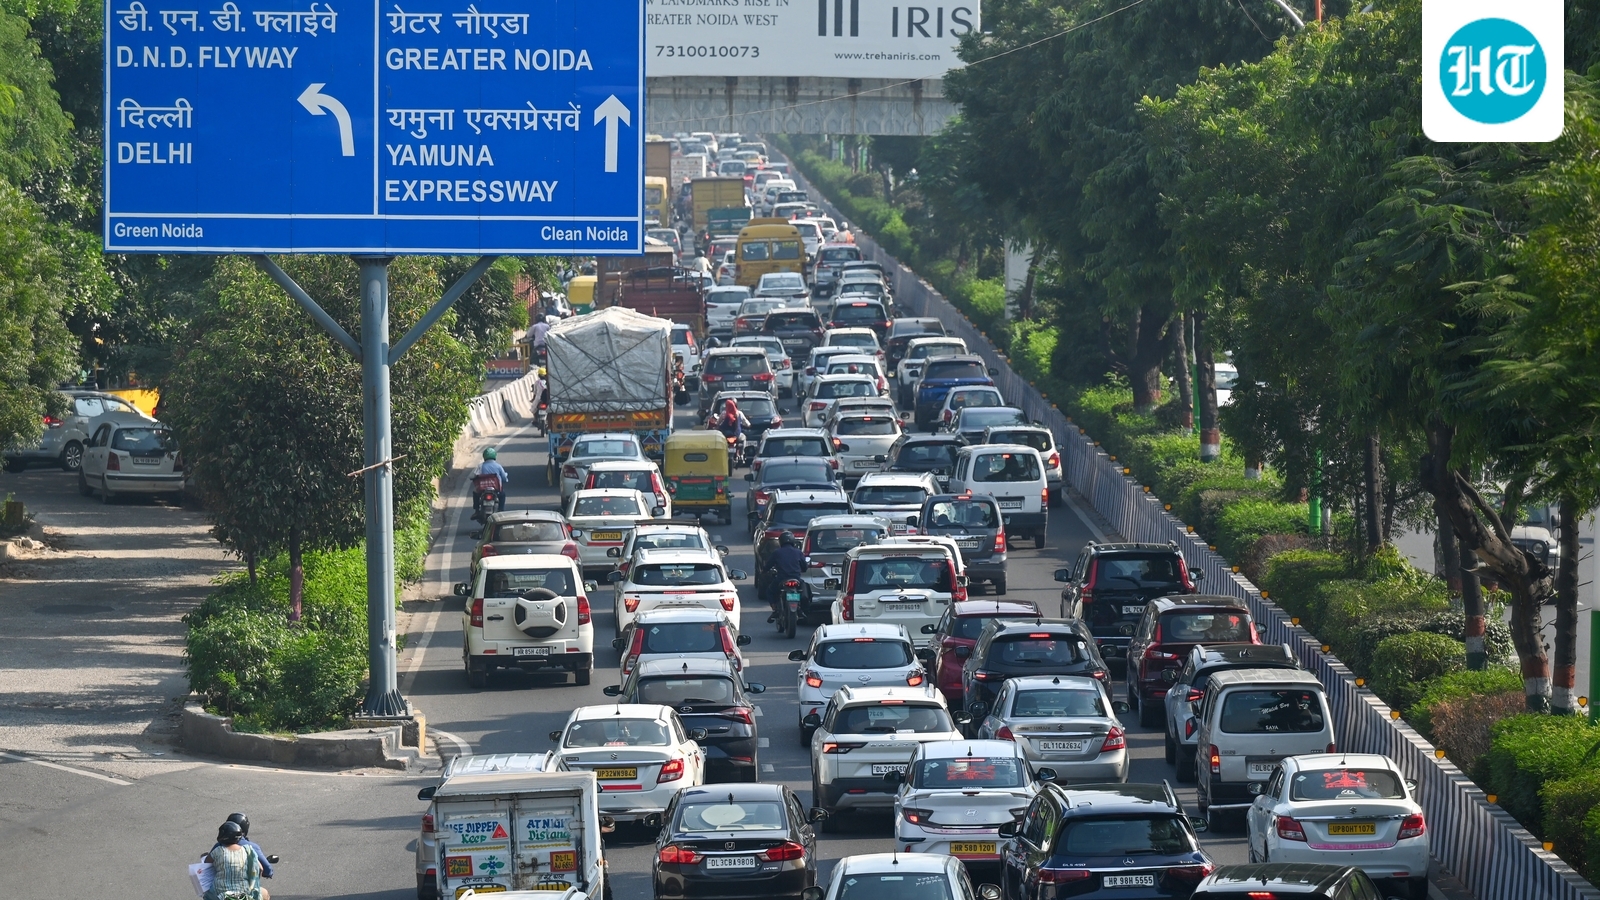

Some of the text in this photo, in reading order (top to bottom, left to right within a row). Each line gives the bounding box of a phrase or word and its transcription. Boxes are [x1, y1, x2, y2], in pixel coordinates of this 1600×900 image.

[116, 2, 338, 37] डी. एन. डी. फ्लाईवे
[386, 4, 530, 38] ग्रेटर नौएडा
[697, 14, 739, 25] NOIDA
[743, 14, 778, 26] WEST
[892, 6, 973, 38] IRIS
[199, 46, 298, 69] FLYWAY
[385, 48, 593, 71] GREATER NOIDA
[655, 45, 760, 58] 7310010073
[834, 52, 941, 61] www.trehaniris.com
[117, 98, 193, 128] दिल्ली
[386, 108, 454, 139] यमुना
[117, 142, 192, 164] DELHI
[385, 144, 494, 166] YAMUNA
[385, 180, 558, 202] EXPRESSWAY
[114, 223, 204, 238] Green Noida
[541, 226, 628, 241] Clean Noida
[495, 367, 524, 375] POLICE
[526, 819, 541, 829] AT
[1120, 877, 1133, 885] 98H
[1135, 876, 1153, 884] 5555
